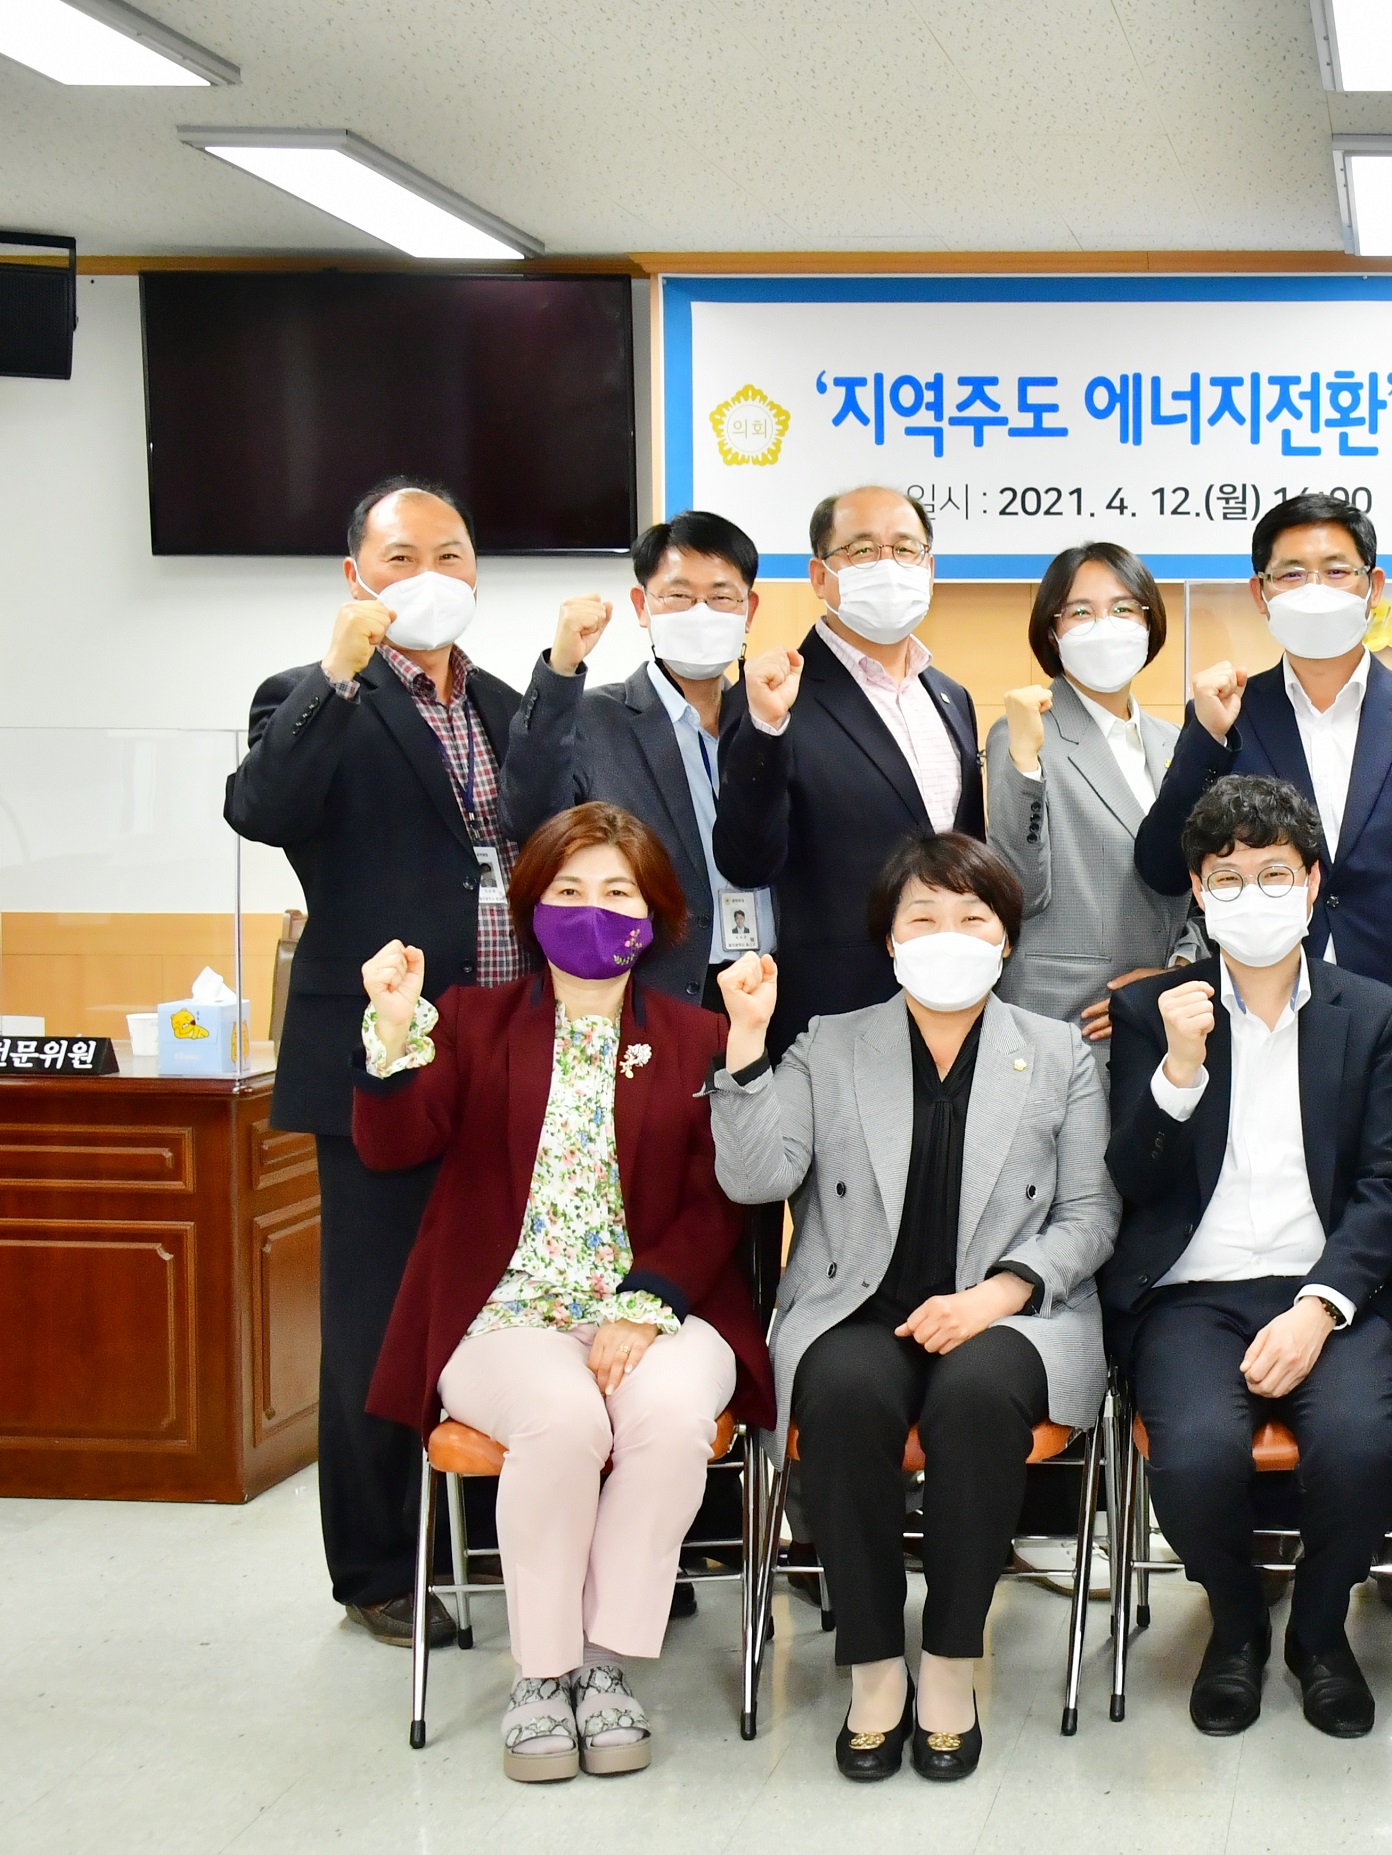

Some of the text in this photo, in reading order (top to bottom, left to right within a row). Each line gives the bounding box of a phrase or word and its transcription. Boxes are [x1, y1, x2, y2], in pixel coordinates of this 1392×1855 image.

[732, 418, 767, 439] 의회
[998, 486, 1096, 518] 2021.
[1104, 486, 1137, 518] 4.
[1150, 482, 1262, 522] 12.(월)
